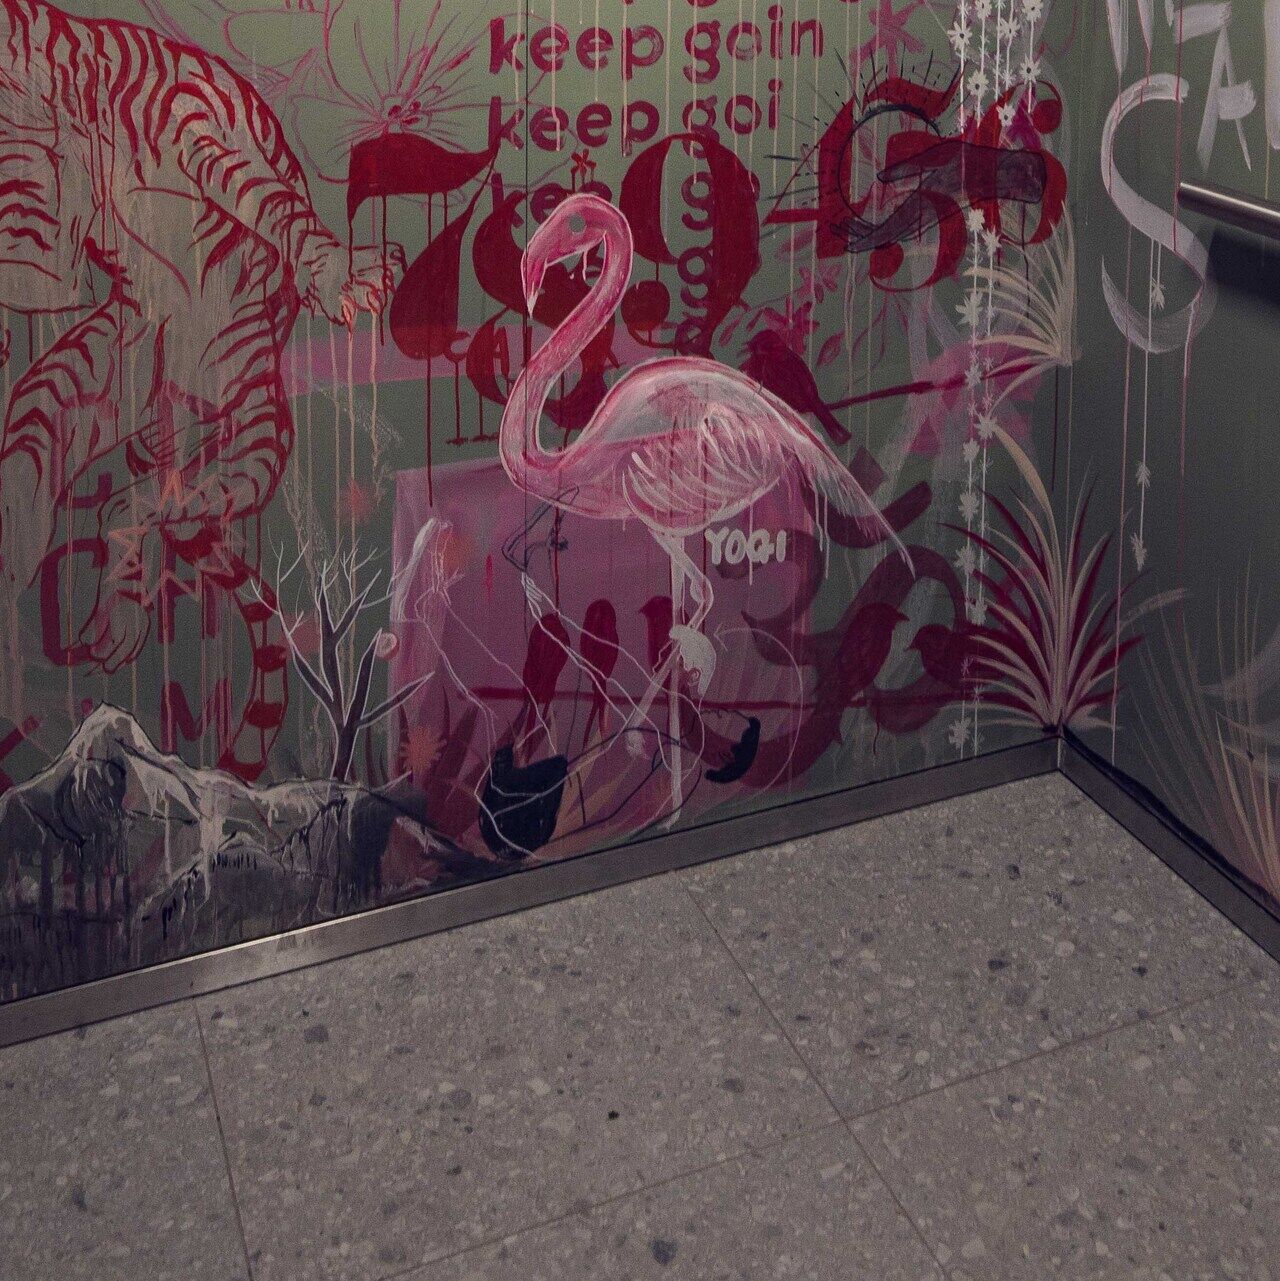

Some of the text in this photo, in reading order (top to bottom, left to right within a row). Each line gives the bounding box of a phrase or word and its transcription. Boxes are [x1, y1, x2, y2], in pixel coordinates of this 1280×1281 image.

[488, 6, 825, 84] keep goin
[487, 95, 661, 157] keep
[704, 527, 788, 565] YOGI
